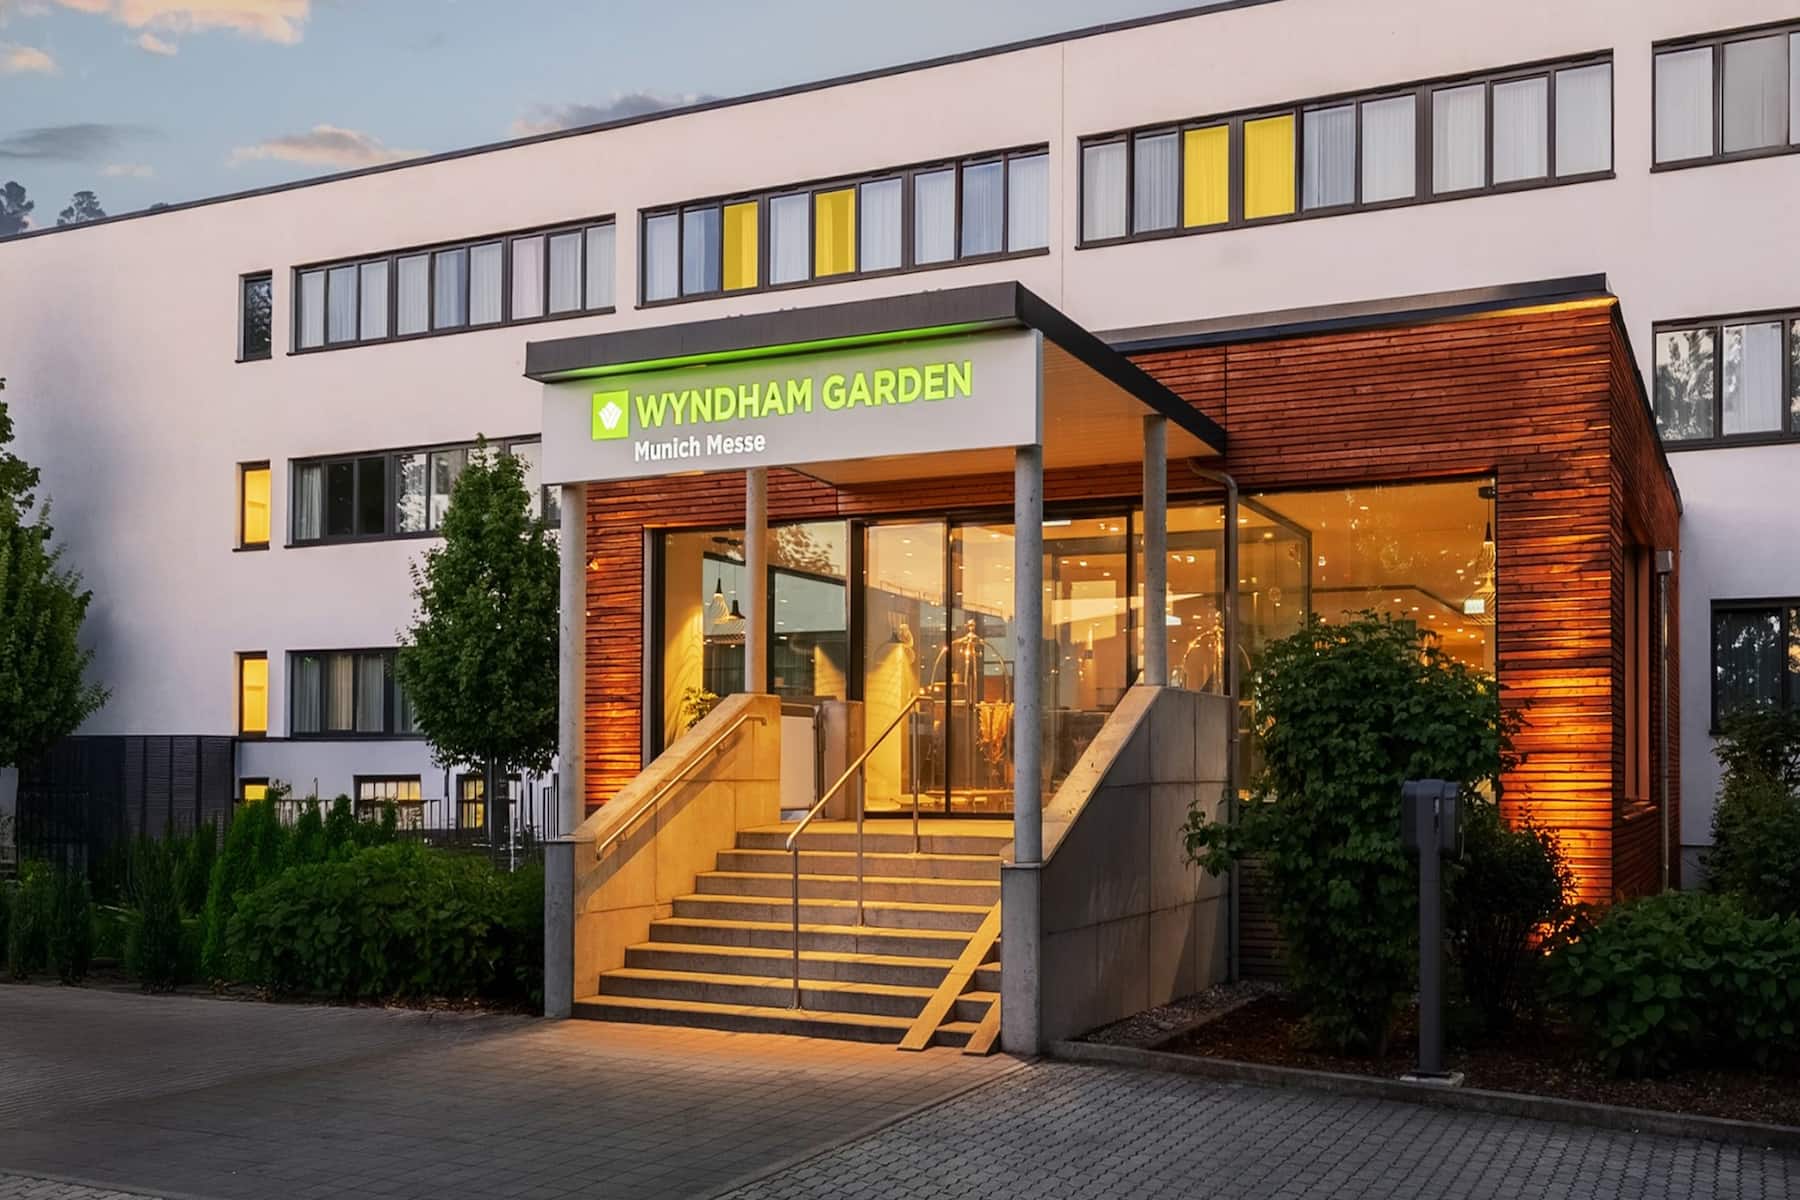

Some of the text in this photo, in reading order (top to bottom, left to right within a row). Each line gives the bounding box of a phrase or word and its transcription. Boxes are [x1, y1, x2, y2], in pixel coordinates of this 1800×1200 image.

[635, 360, 973, 428] WYNDHAM GARDEN
[634, 432, 766, 462] Munich Messe
